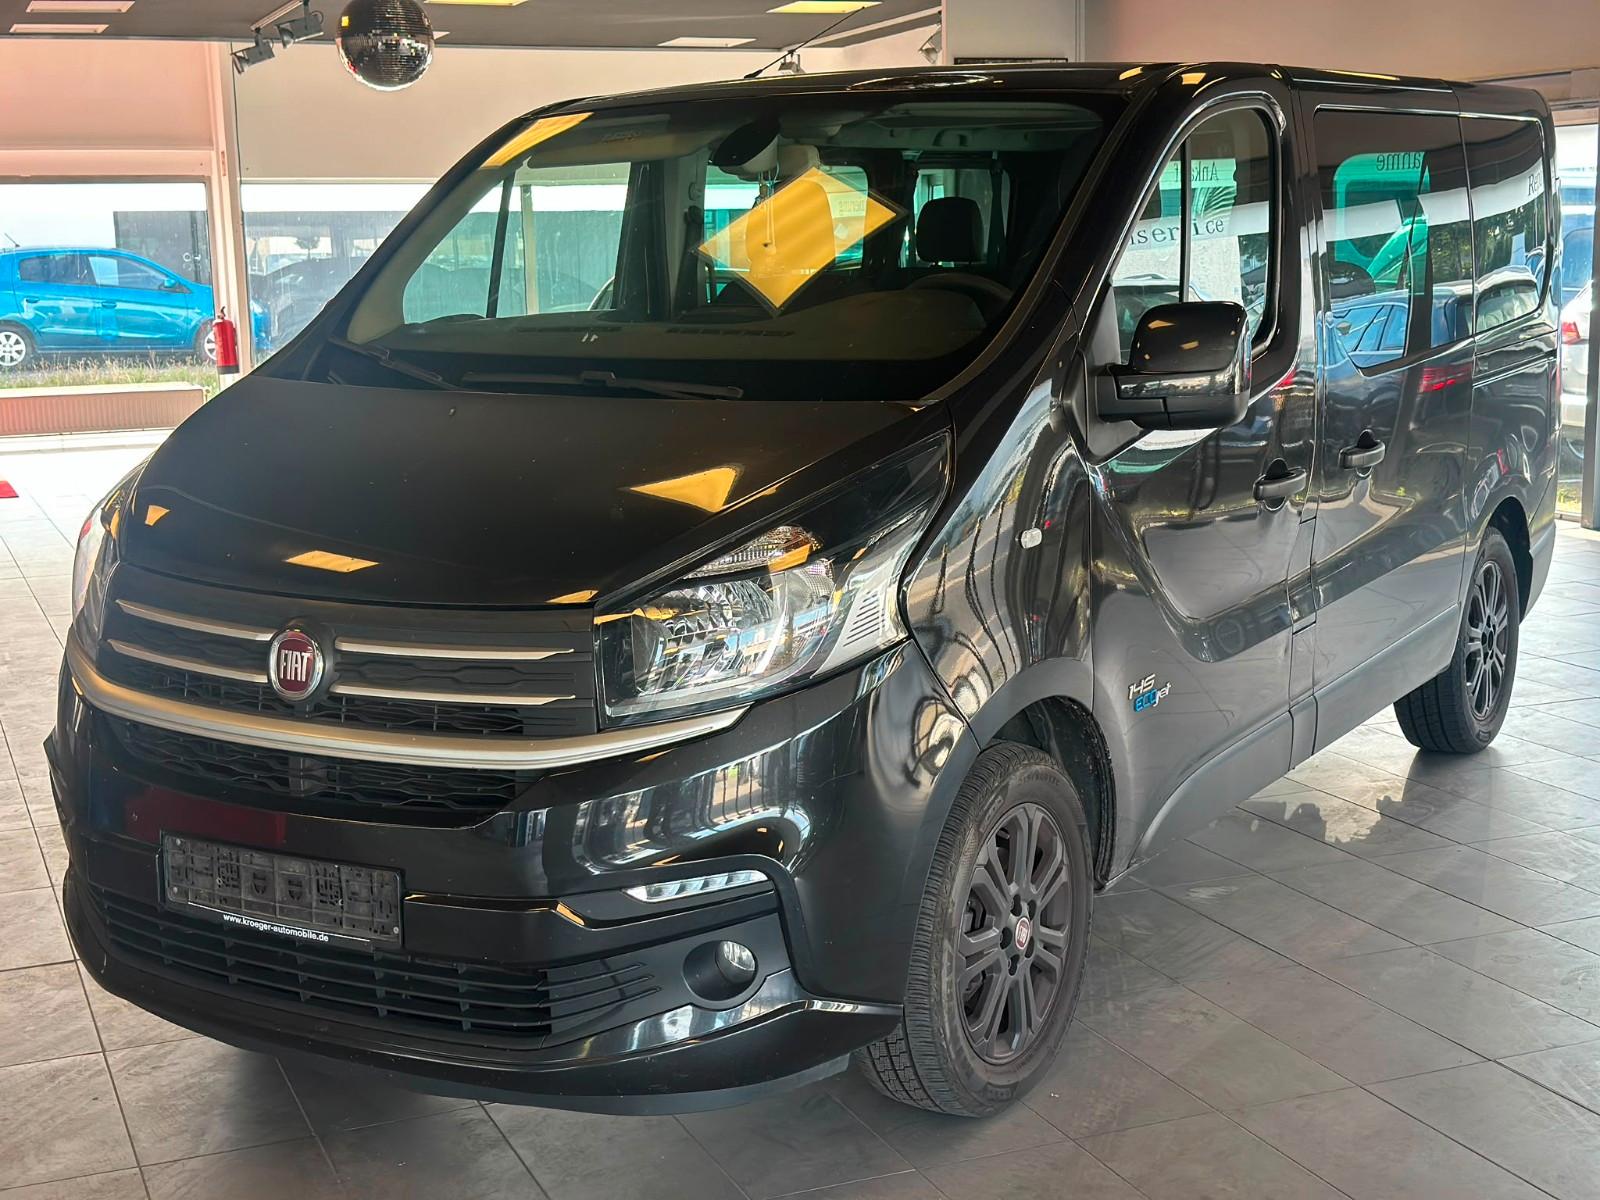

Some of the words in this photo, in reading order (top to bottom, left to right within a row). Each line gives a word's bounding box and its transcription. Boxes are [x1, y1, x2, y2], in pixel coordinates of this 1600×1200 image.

[280, 648, 311, 682] FIAT
[1127, 673, 1156, 700] 145
[222, 913, 330, 942] www.kroeger-automobile.de
